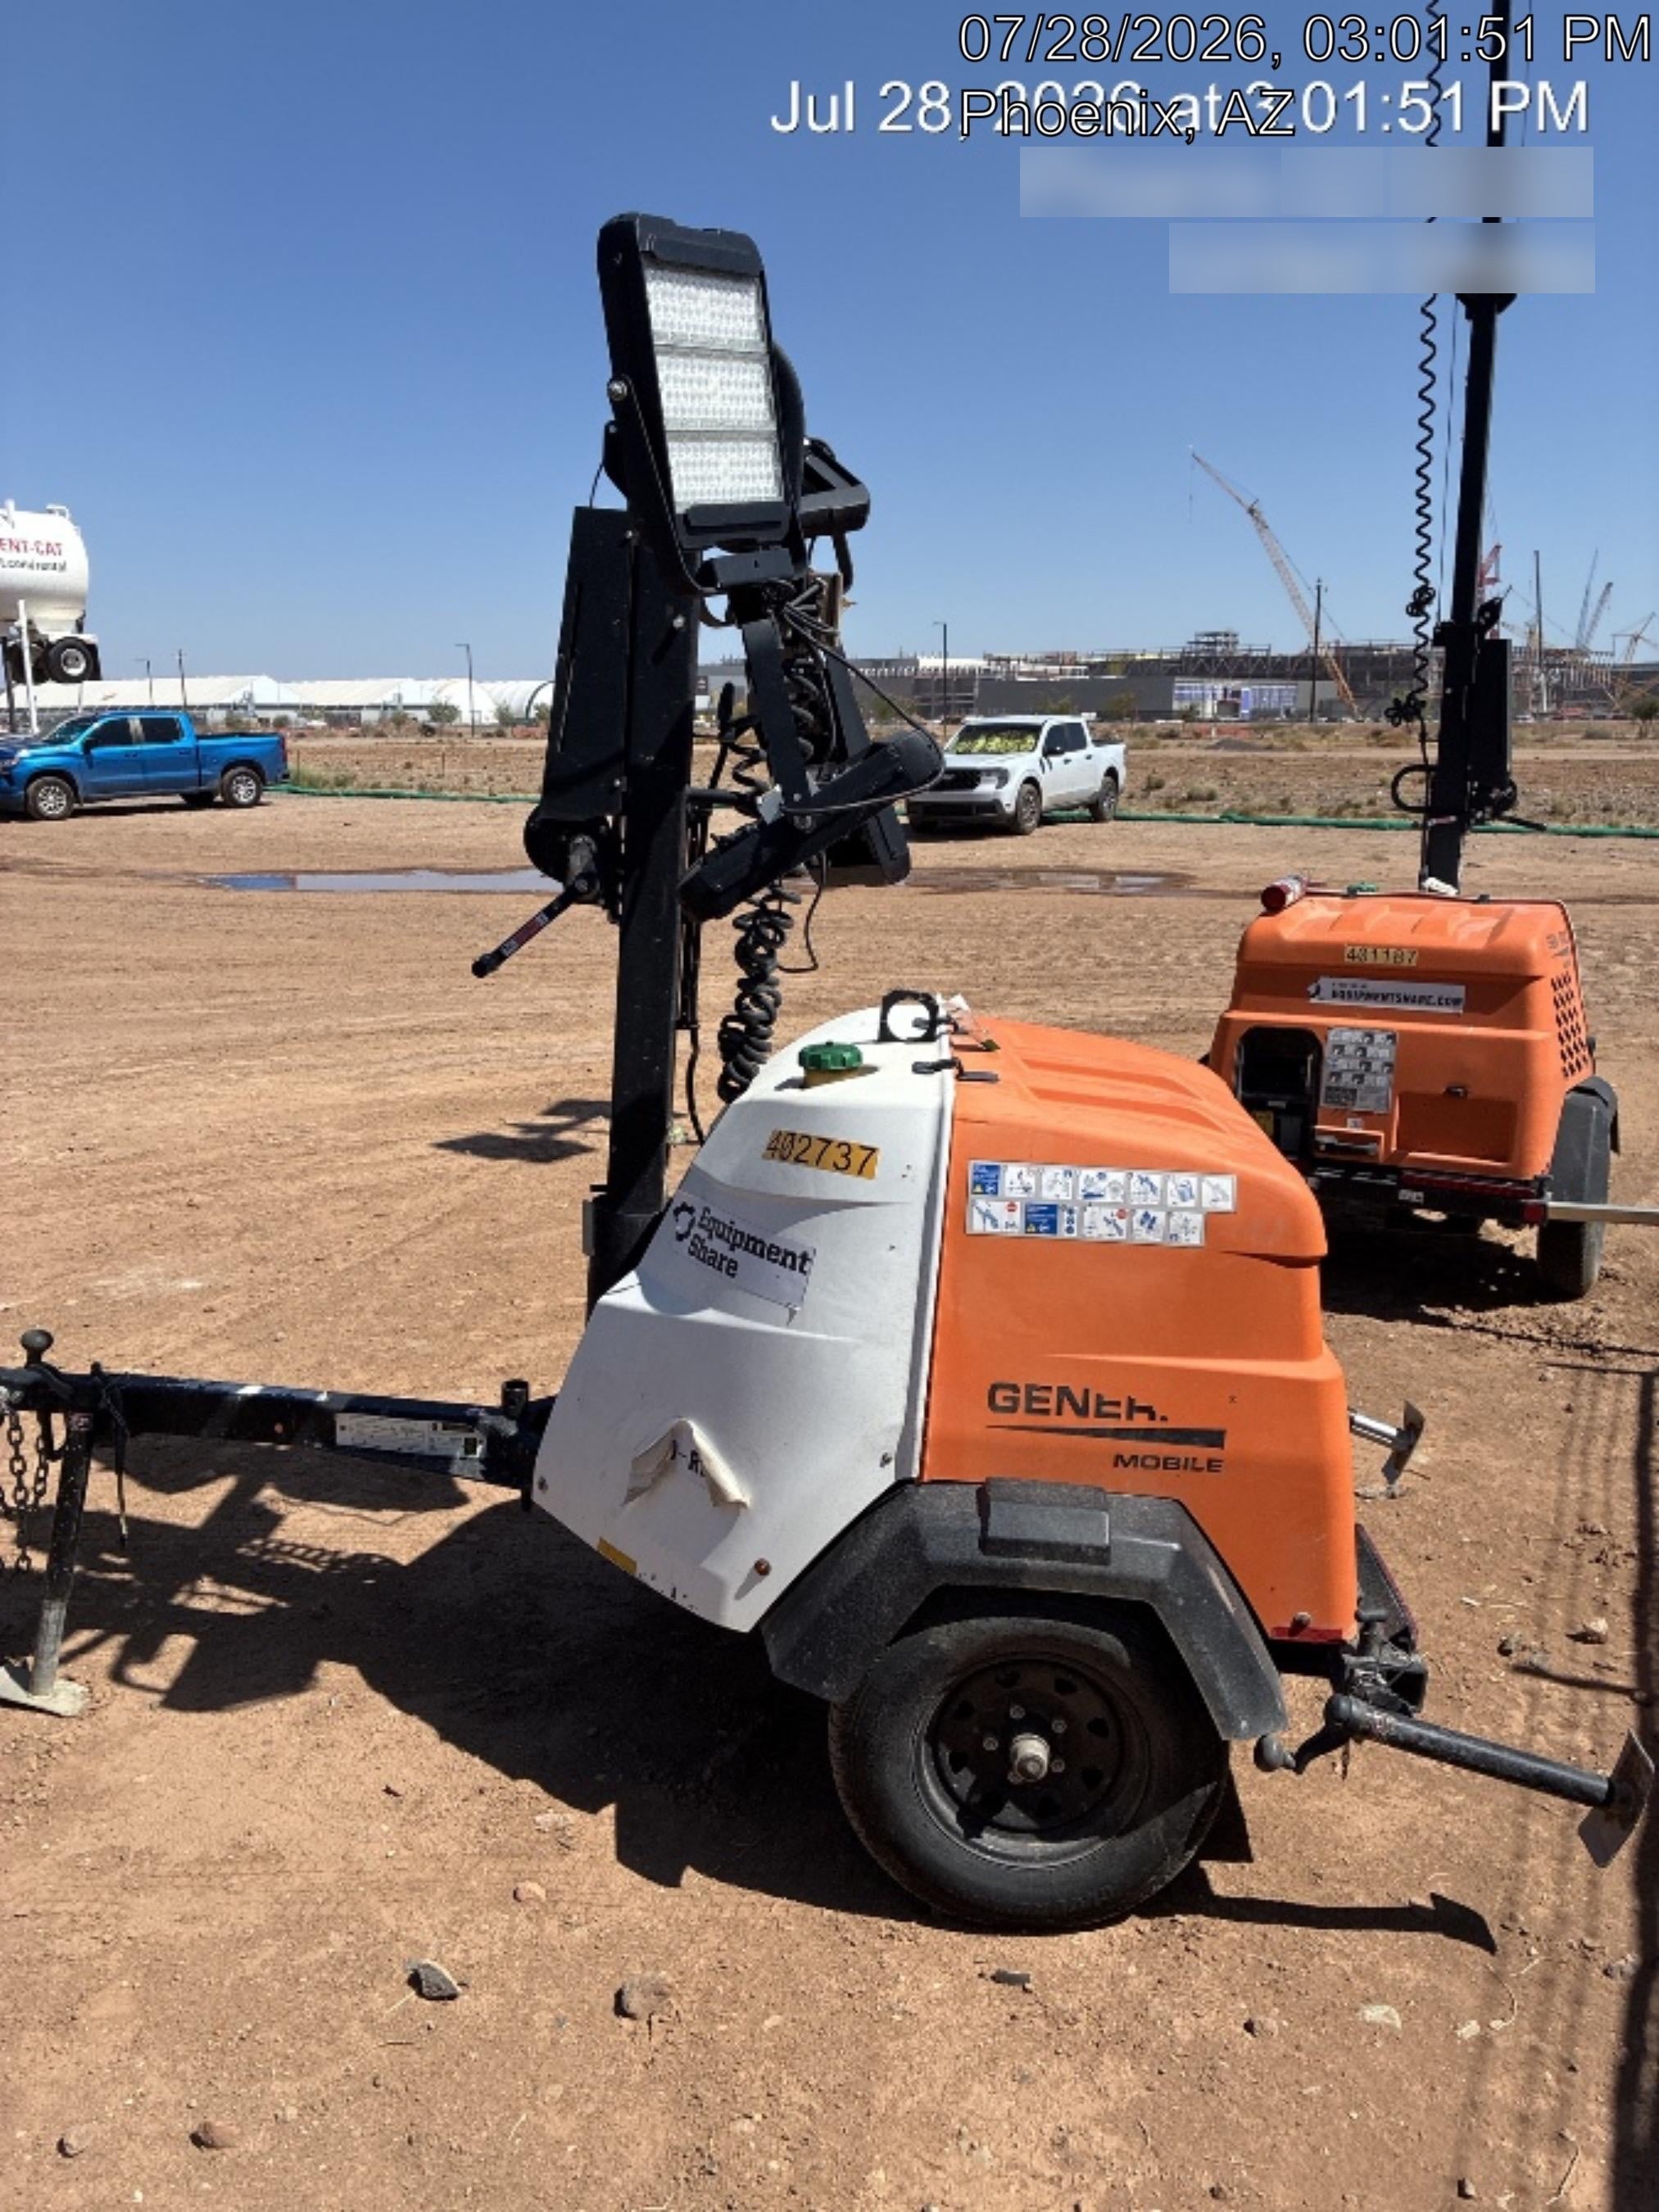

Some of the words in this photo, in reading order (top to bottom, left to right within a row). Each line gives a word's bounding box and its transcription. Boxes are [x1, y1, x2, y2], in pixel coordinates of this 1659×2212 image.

[767, 1131, 879, 1176] 402737
[687, 1234, 738, 1278] Share
[698, 1206, 814, 1276] Equipment
[1113, 1454, 1224, 1473] MOBILE
